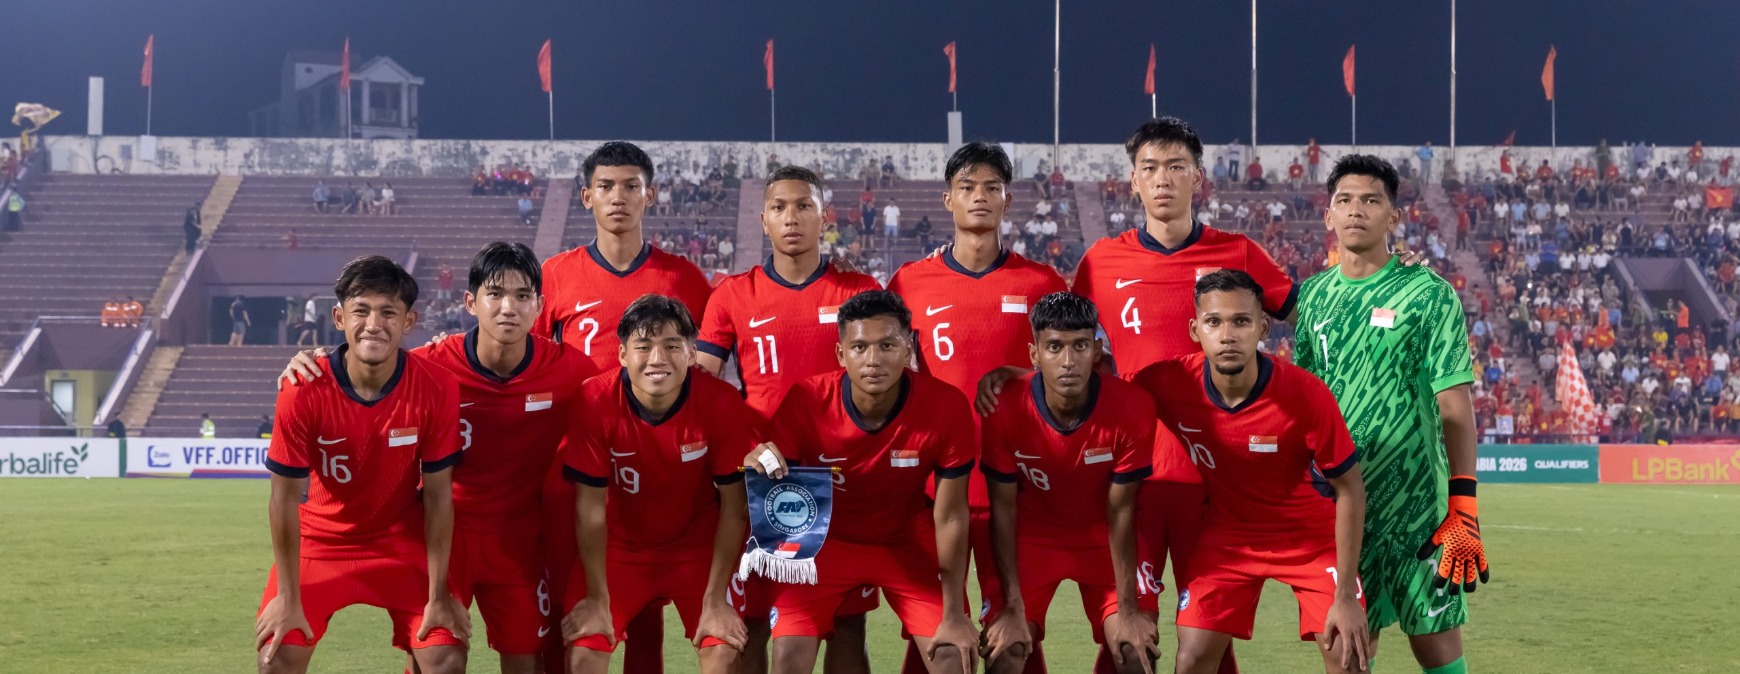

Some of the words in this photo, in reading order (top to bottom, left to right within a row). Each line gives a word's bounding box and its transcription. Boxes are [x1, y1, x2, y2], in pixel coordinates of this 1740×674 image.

[1121, 297, 1142, 335] 4
[753, 335, 779, 374] 11
[933, 322, 954, 361] 6
[1320, 334, 1328, 371] 1
[319, 448, 352, 484] 16
[610, 458, 640, 494] 19
[1016, 463, 1051, 491] 18
[1499, 457, 1527, 472] 2026
[1534, 459, 1590, 470] QUALIFIERS
[1632, 457, 1731, 481] LPBank
[767, 487, 783, 515] FOOTBALL
[786, 486, 815, 516] ASSOCIATION
[773, 522, 809, 533] SINGAPORE
[537, 578, 550, 616] 8
